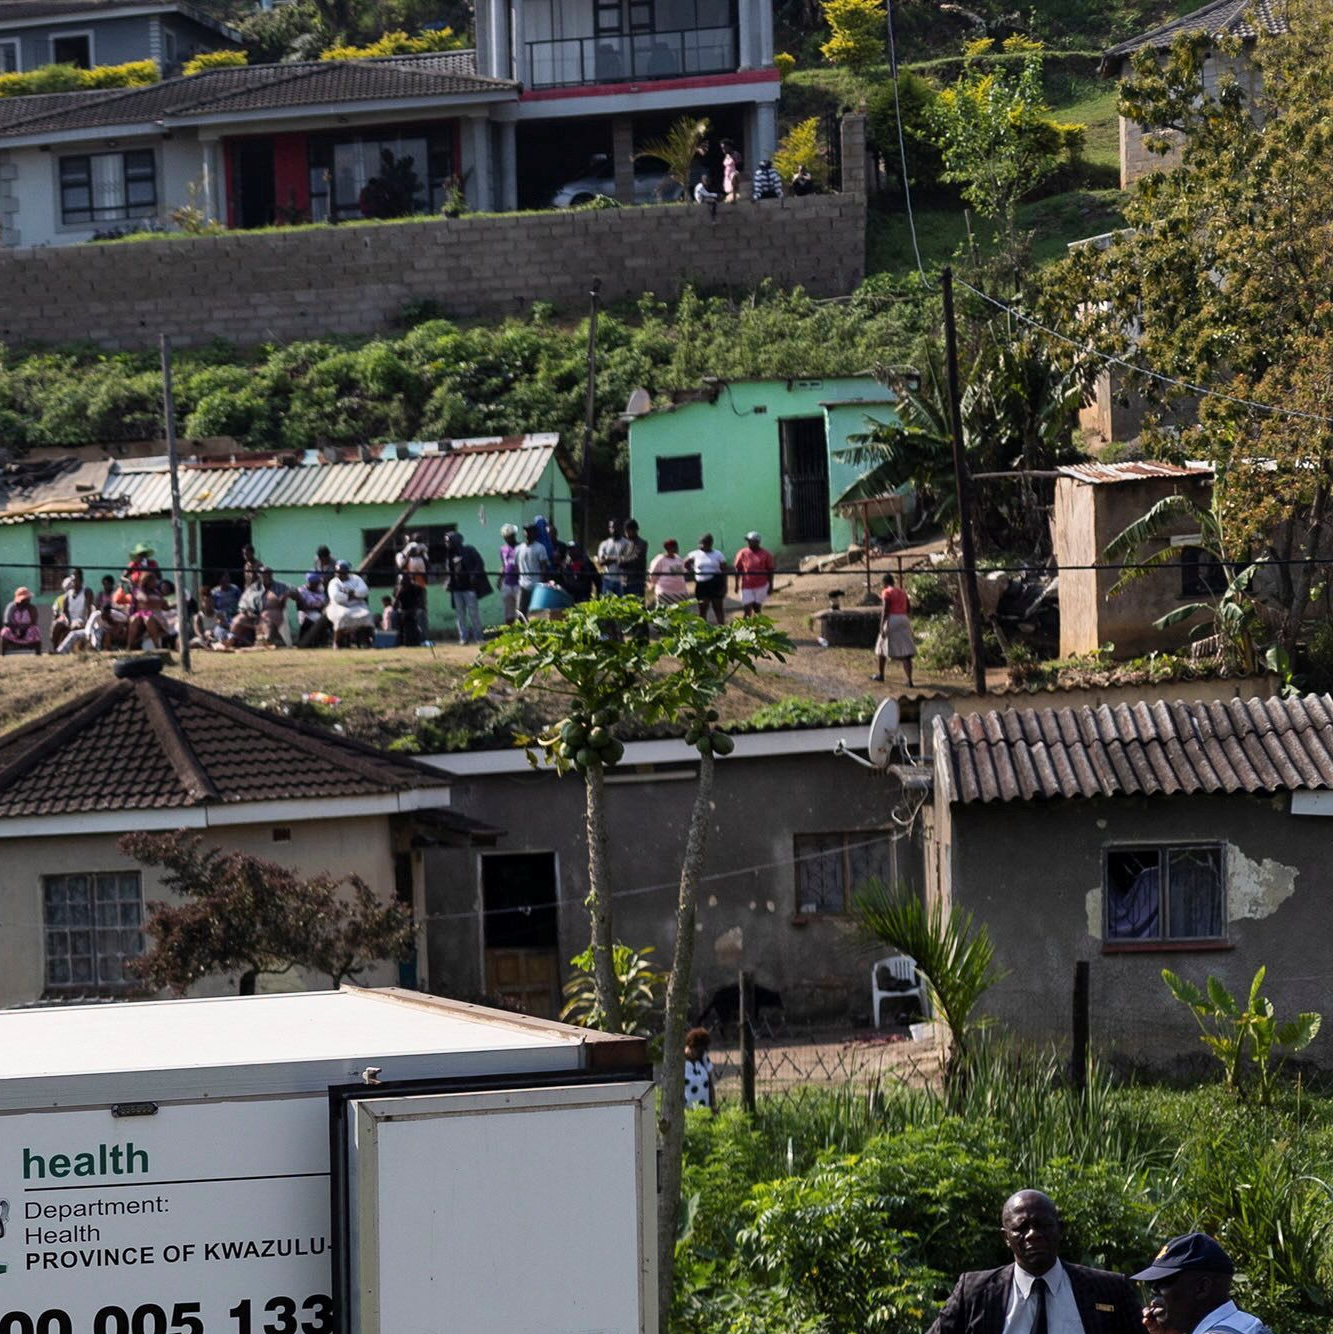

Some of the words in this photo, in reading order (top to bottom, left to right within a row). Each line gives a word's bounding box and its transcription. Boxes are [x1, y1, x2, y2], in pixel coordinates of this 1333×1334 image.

[23, 1143, 149, 1179] health
[24, 1196, 170, 1222] Department:
[25, 1225, 101, 1245] Health
[26, 1247, 155, 1270] PROVINCE
[163, 1244, 196, 1263] OF
